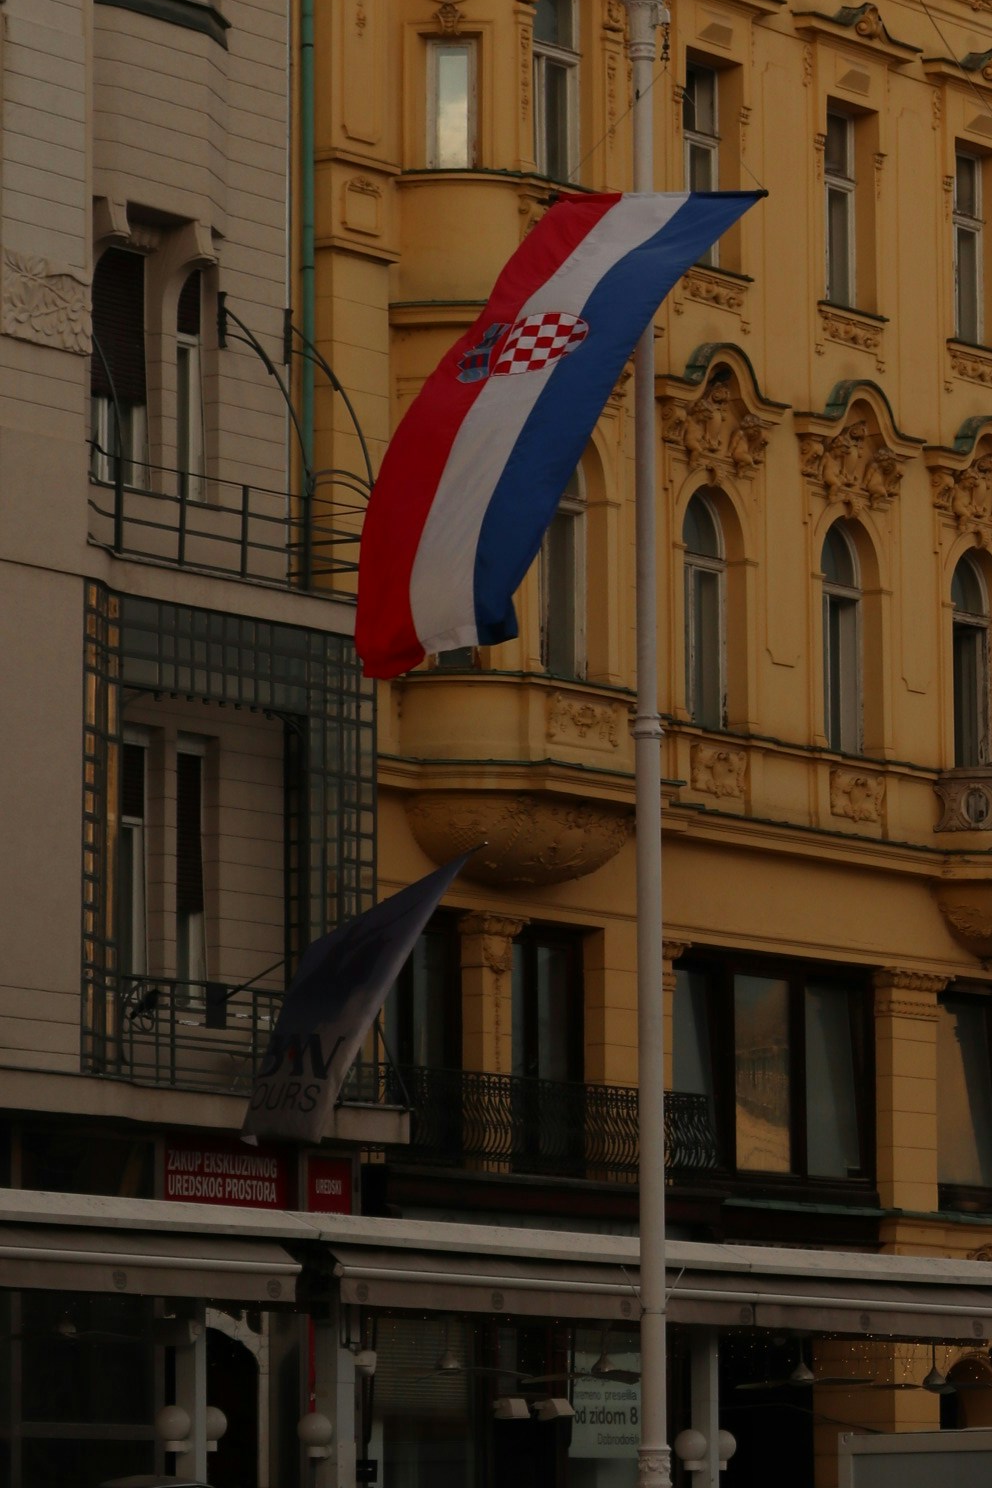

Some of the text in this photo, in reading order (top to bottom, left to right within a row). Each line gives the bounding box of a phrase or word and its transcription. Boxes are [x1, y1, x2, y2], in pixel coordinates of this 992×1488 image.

[167, 1149, 278, 1179] ZAKUP EKSKLUZIVNOG
[168, 1174, 278, 1203] UREDSKOG PROSTORA
[315, 1178, 343, 1195] UREDSKI
[574, 1406, 639, 1425] od zidom 8
